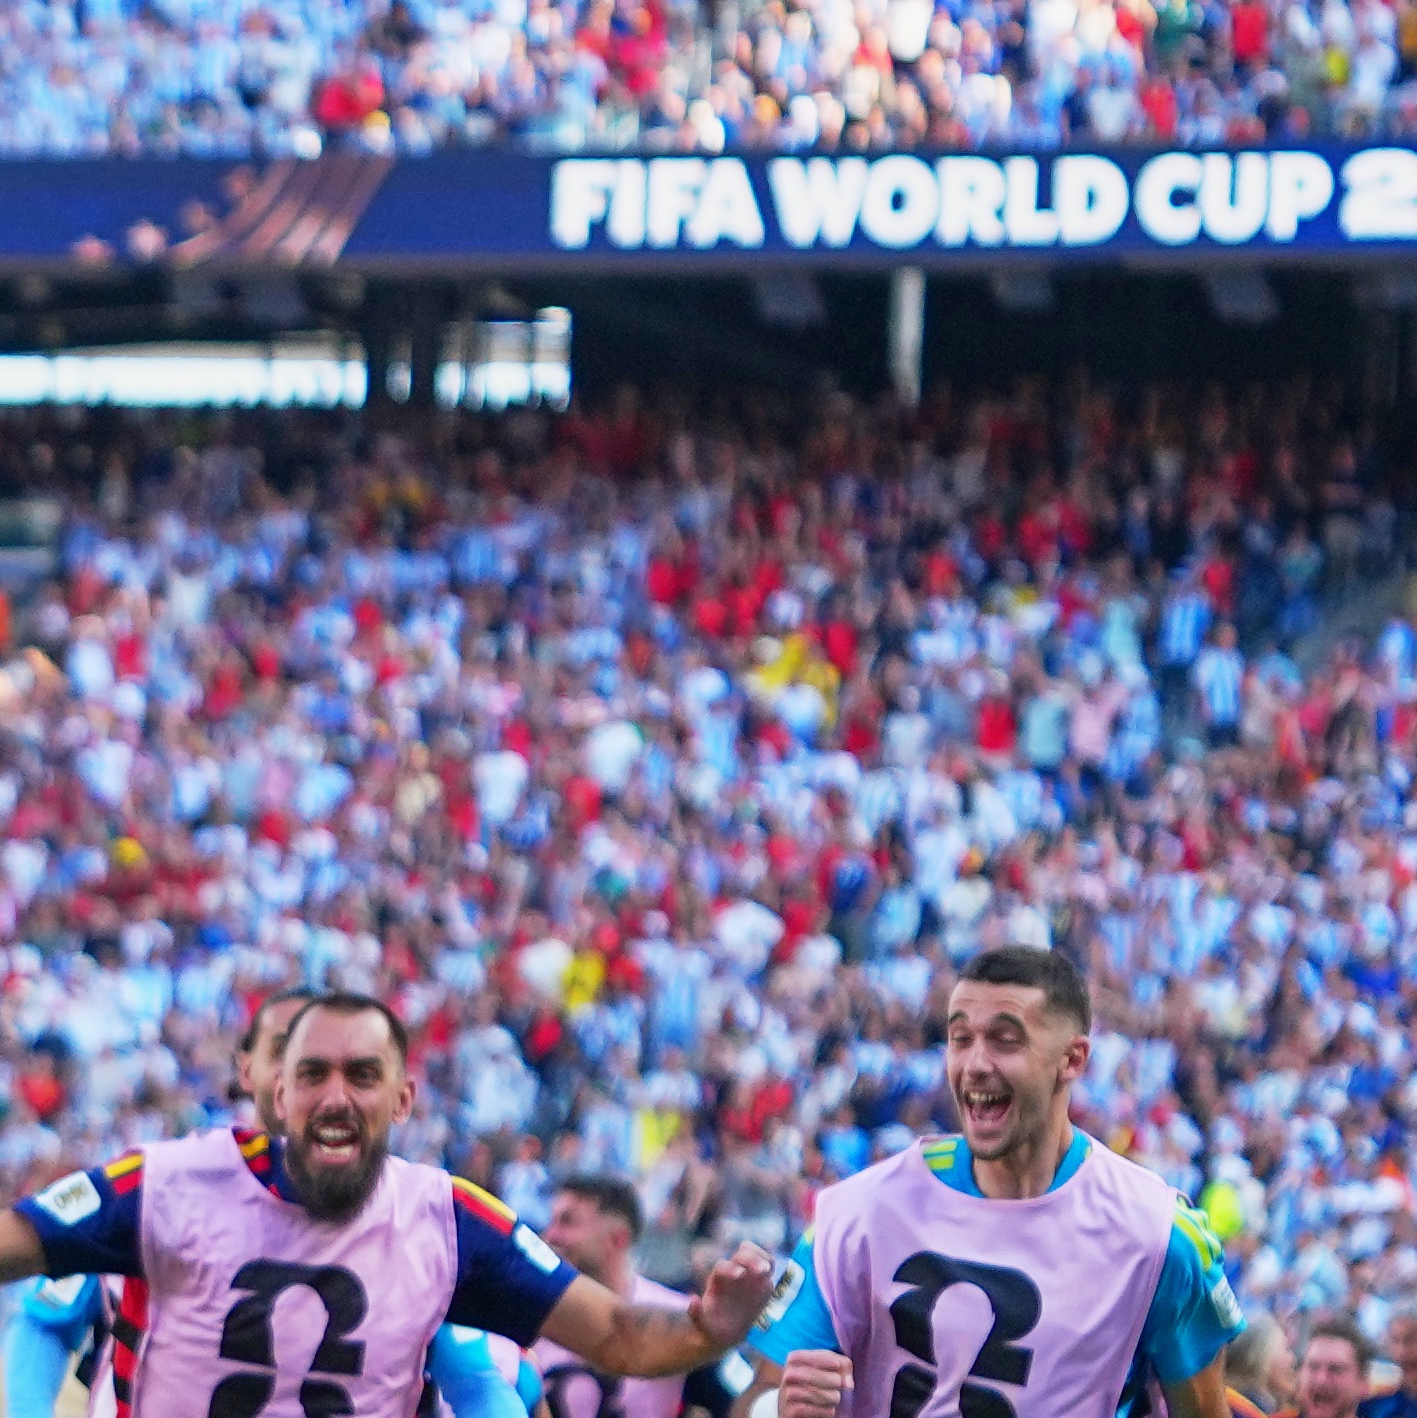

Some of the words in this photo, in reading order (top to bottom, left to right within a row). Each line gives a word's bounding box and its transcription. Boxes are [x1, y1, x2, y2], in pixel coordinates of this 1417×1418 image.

[551, 156, 765, 249] FIFA
[767, 154, 1129, 249] WORLD
[1134, 150, 1333, 246] CUP
